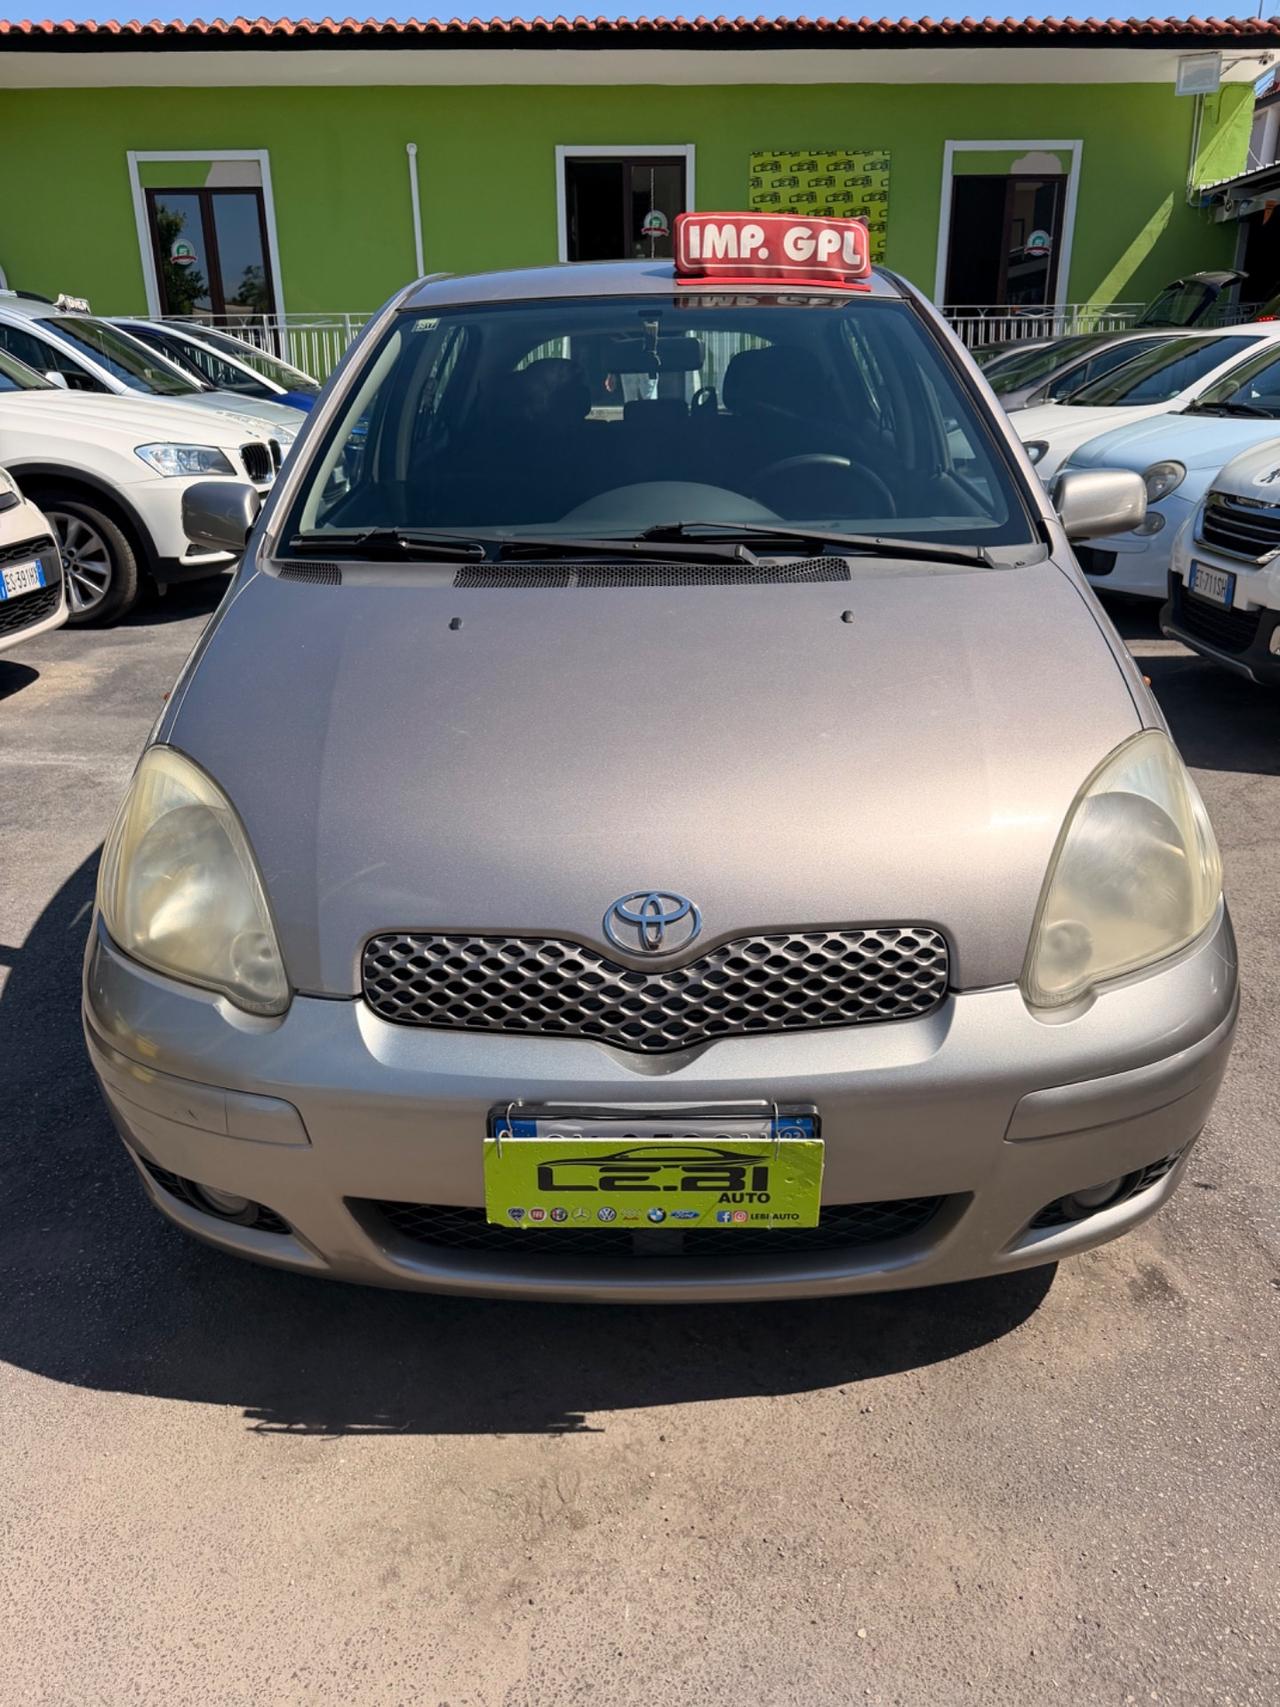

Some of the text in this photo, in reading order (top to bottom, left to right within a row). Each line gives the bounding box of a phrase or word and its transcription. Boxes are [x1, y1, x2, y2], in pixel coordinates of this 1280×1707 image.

[688, 223, 769, 260] IMP.
[783, 226, 861, 265] GPL
[718, 1192, 771, 1204] AUTO
